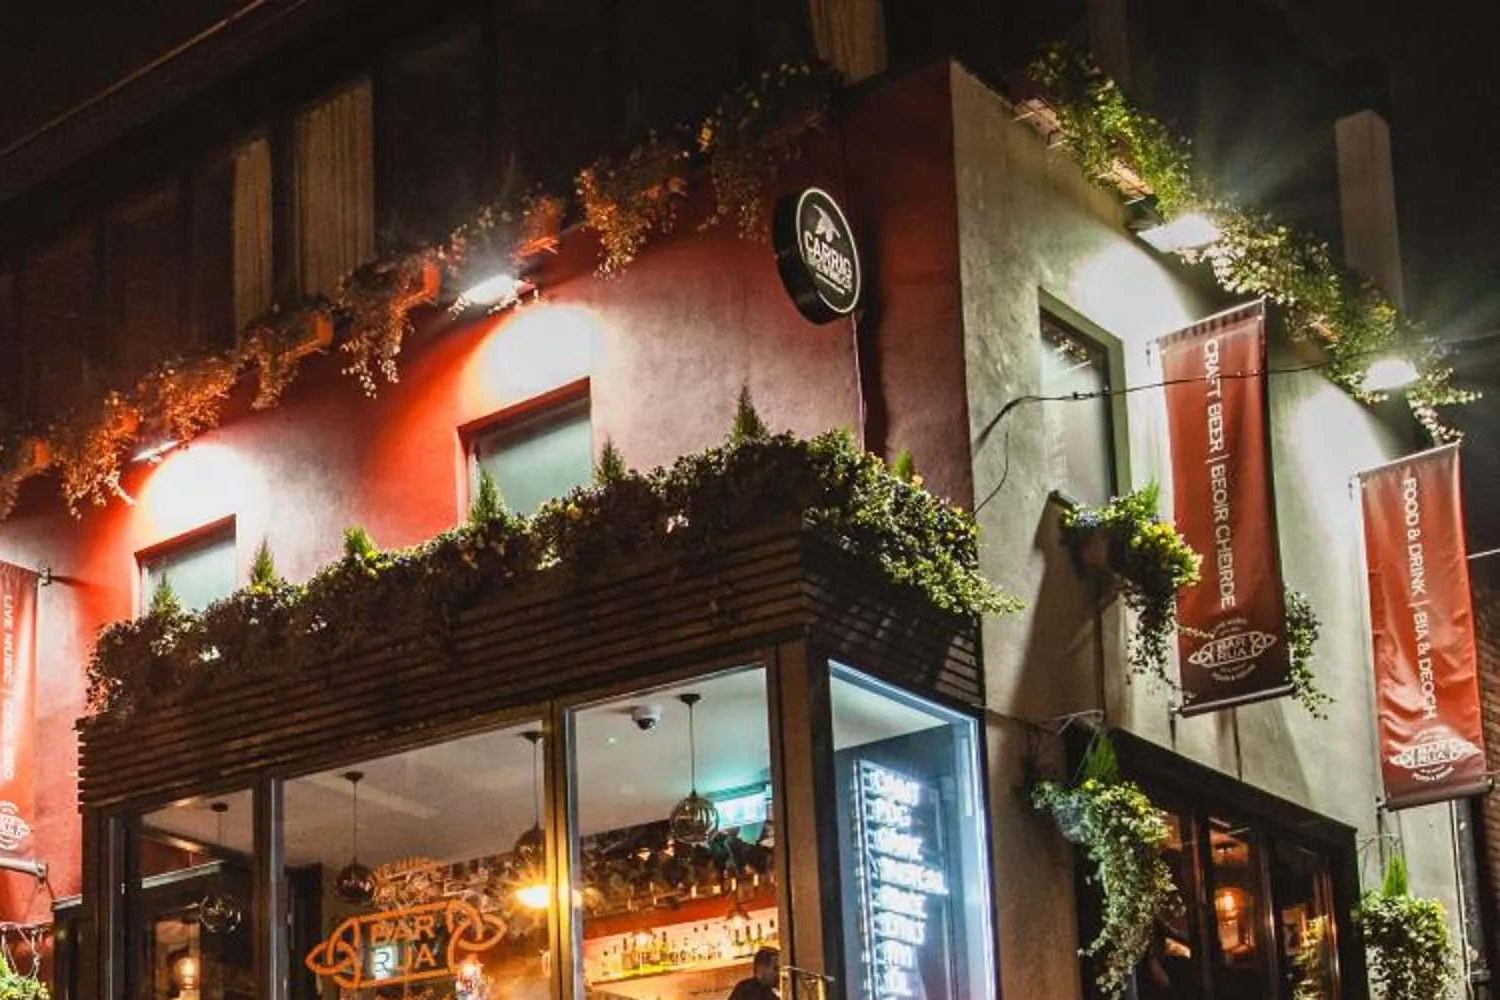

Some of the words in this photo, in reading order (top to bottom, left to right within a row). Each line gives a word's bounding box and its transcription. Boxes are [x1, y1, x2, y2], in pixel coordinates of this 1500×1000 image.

[1207, 403, 1224, 452] BEER
[1211, 464, 1229, 523] BEOIR
[1403, 478, 1419, 527] FOOD
[1407, 527, 1421, 541] &
[1215, 525, 1236, 610] CHEIRDE
[1408, 543, 1428, 598] DRINK
[1413, 611, 1429, 641] BIA
[1418, 657, 1438, 720] DEOCH
[369, 914, 436, 946] BAR
[372, 943, 437, 975] RUA
